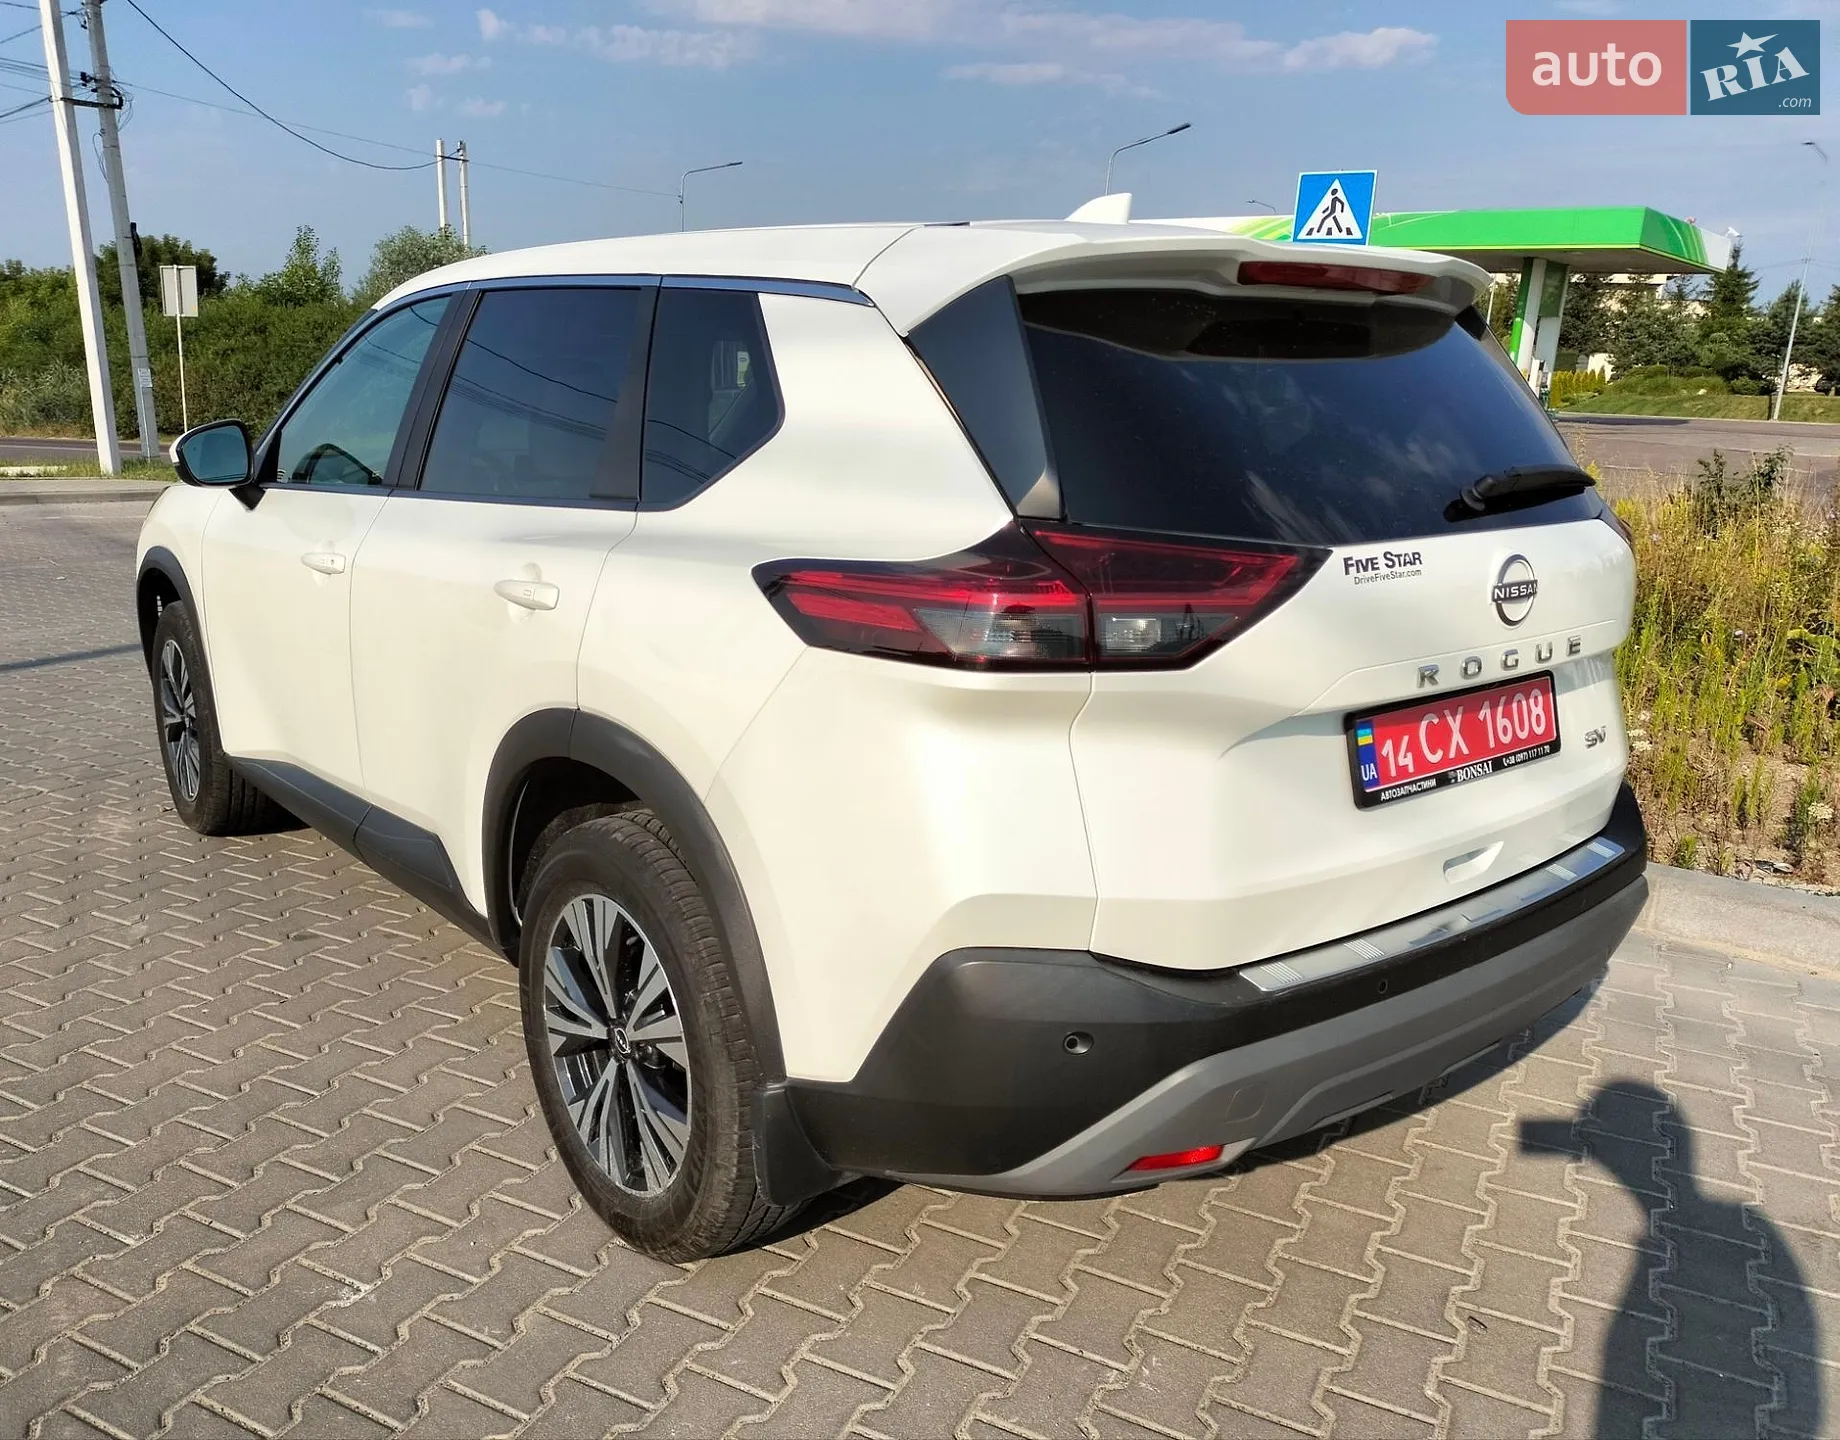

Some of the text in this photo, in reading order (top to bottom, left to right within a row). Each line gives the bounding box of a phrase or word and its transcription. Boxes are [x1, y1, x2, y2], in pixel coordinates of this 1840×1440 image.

[1354, 569, 1422, 585] DriveFiveStar.com
[1417, 635, 1582, 689] ROGUE
[1381, 688, 1546, 777] 14 CX 1608
[1585, 725, 1606, 750] SV
[1361, 763, 1378, 781] UA
[1457, 761, 1493, 782] BONSAI
[1381, 778, 1437, 801] АВТОЗАПЧАСТИНИ
